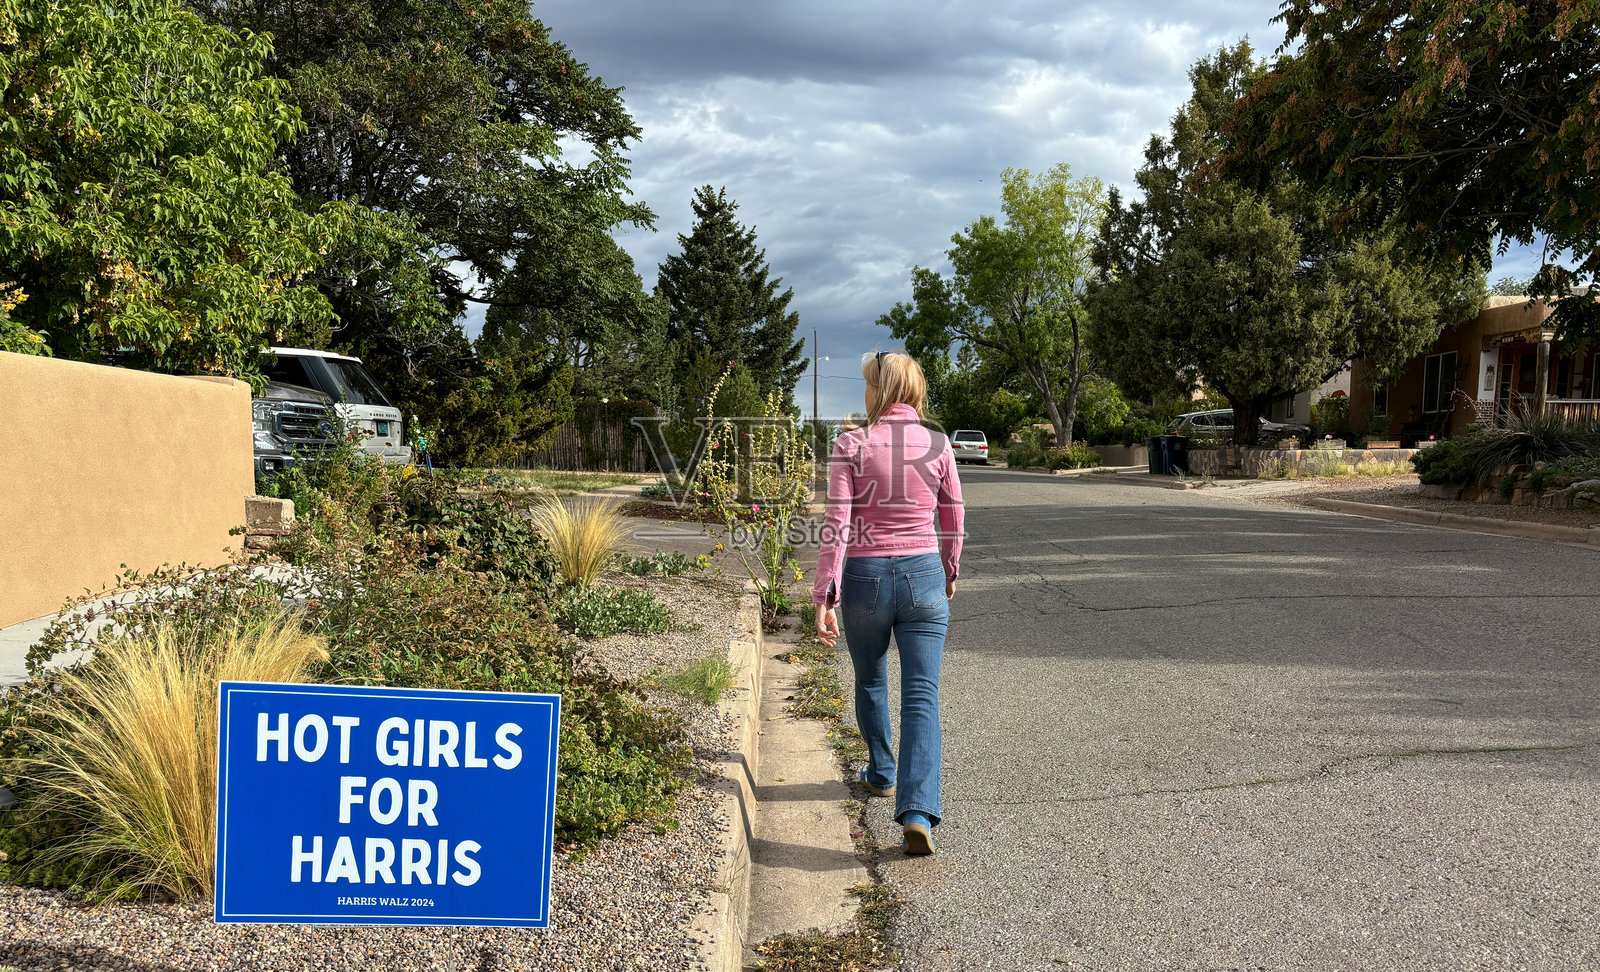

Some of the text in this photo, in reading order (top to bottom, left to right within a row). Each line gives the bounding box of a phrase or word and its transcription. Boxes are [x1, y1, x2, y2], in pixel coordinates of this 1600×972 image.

[256, 712, 523, 770] HOT GIRLS
[338, 775, 439, 827] FOR
[290, 835, 482, 887] HARRIS
[337, 896, 435, 907] HARRIS WALZ 2024
